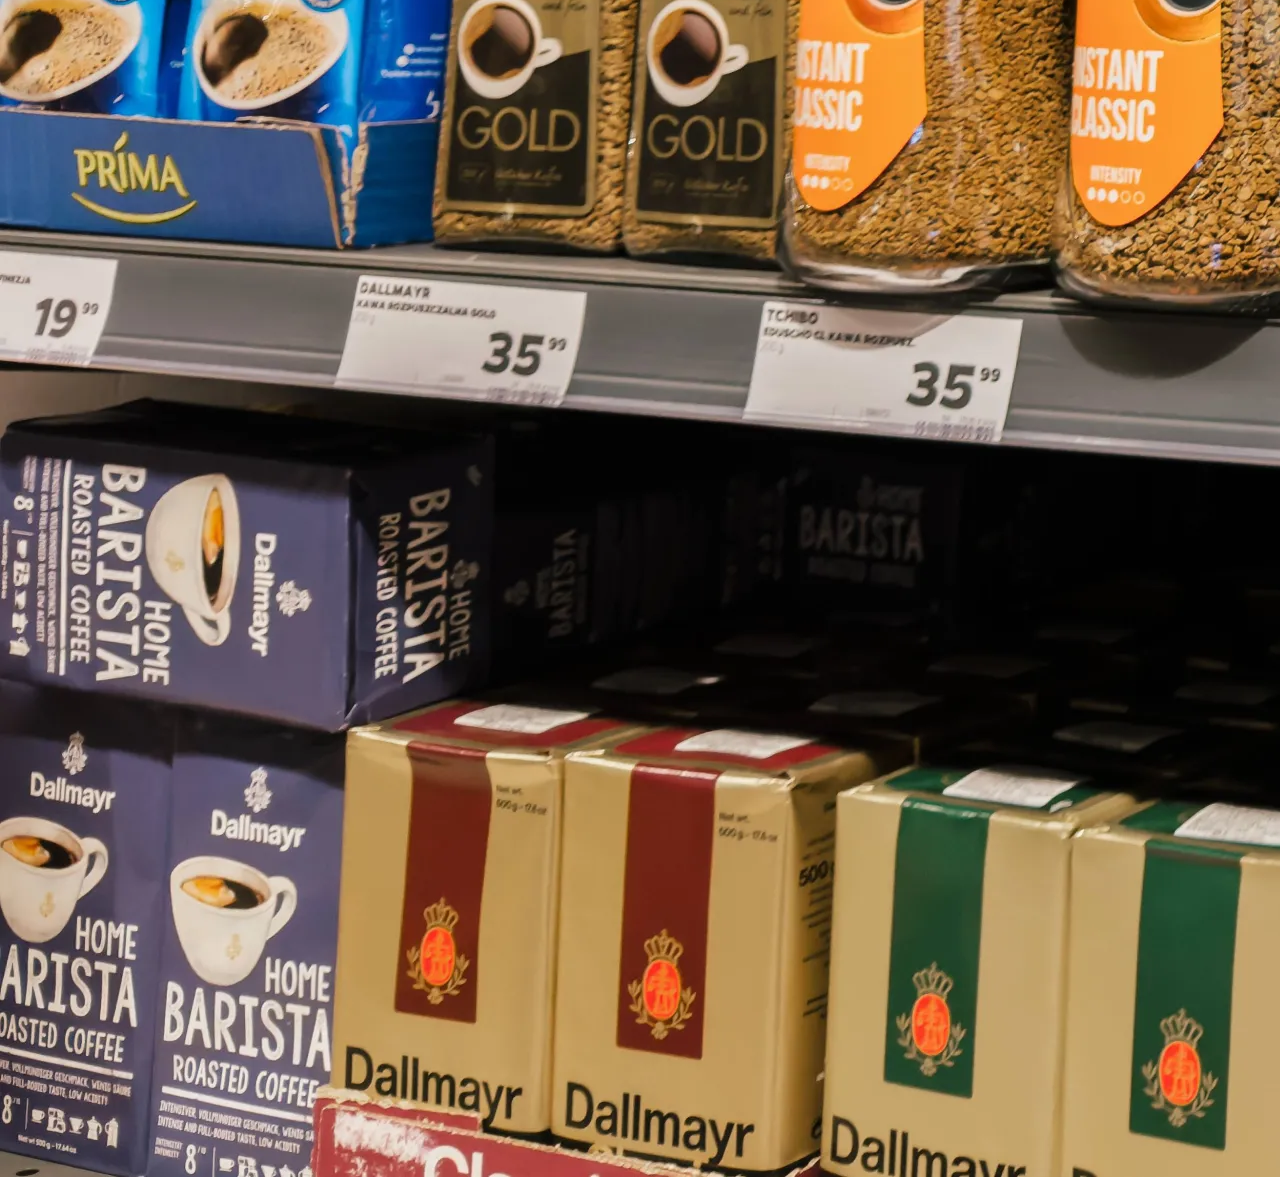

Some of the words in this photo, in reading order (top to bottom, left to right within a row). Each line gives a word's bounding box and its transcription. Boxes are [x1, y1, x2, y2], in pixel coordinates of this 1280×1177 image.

[457, 105, 581, 153] GOLD
[647, 114, 768, 162] GOLD
[360, 281, 430, 299] DALLMAYR
[35, 298, 77, 339] 19
[767, 308, 818, 324] TCHIBO
[481, 331, 545, 377] 35
[906, 360, 976, 409] 35
[70, 473, 95, 575] ROASTED
[95, 464, 147, 683] BARISTA
[376, 511, 401, 600] ROASTED
[249, 532, 278, 657] Dallmayr
[402, 488, 452, 684] BARISTA
[70, 585, 92, 664] COFFEE
[142, 600, 171, 686] HOME
[374, 608, 398, 680] COFFEE
[30, 771, 116, 813] Dallmayr
[211, 809, 306, 852] Dallmayr
[75, 915, 138, 960] HOME
[0, 943, 137, 1028] ARISTA
[265, 956, 332, 1003] HOME
[64, 1026, 126, 1063] COFFEE
[163, 980, 332, 1072] BARISTA
[172, 1054, 249, 1096] ROASTED
[255, 1070, 319, 1108] COFFEE
[345, 1045, 523, 1127] Dallmayr
[2, 1094, 12, 1124] 8
[565, 1081, 755, 1164] Dallmayr
[185, 1144, 197, 1175] 8
